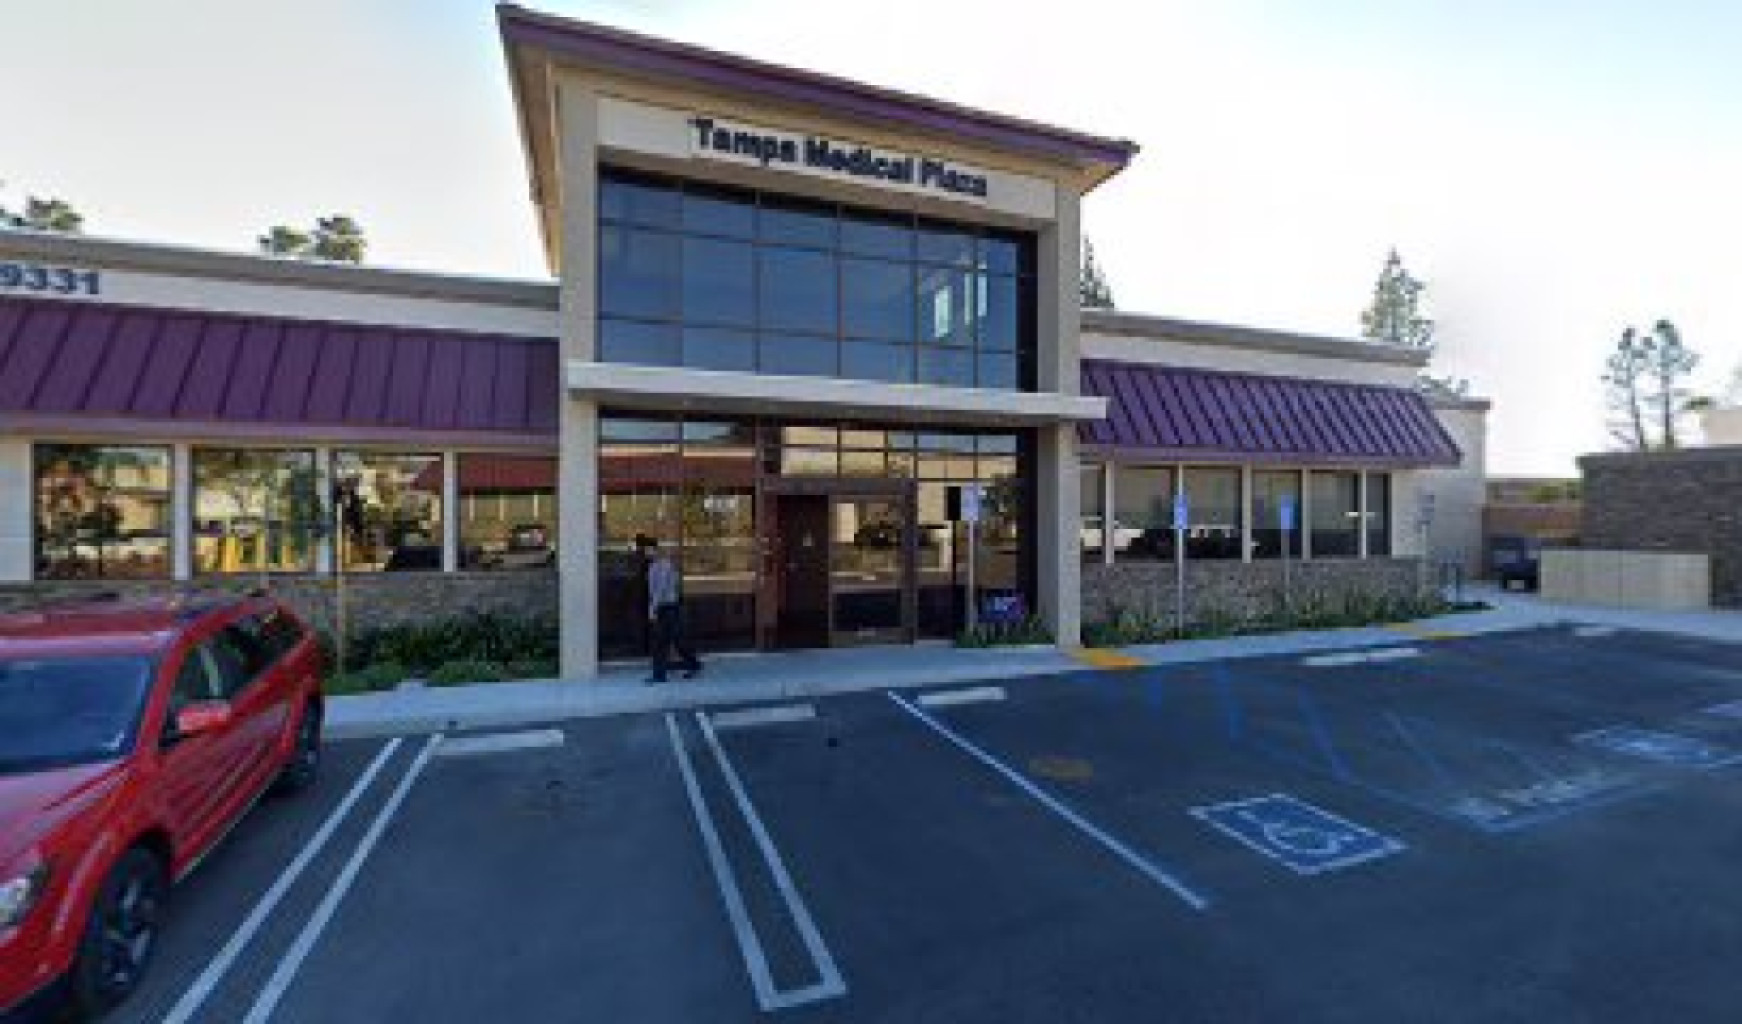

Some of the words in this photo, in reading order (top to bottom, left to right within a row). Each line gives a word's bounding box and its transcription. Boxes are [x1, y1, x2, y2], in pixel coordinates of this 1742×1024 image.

[690, 119, 795, 165] Tampa
[806, 138, 913, 184] Medical
[921, 158, 987, 196] Plaza
